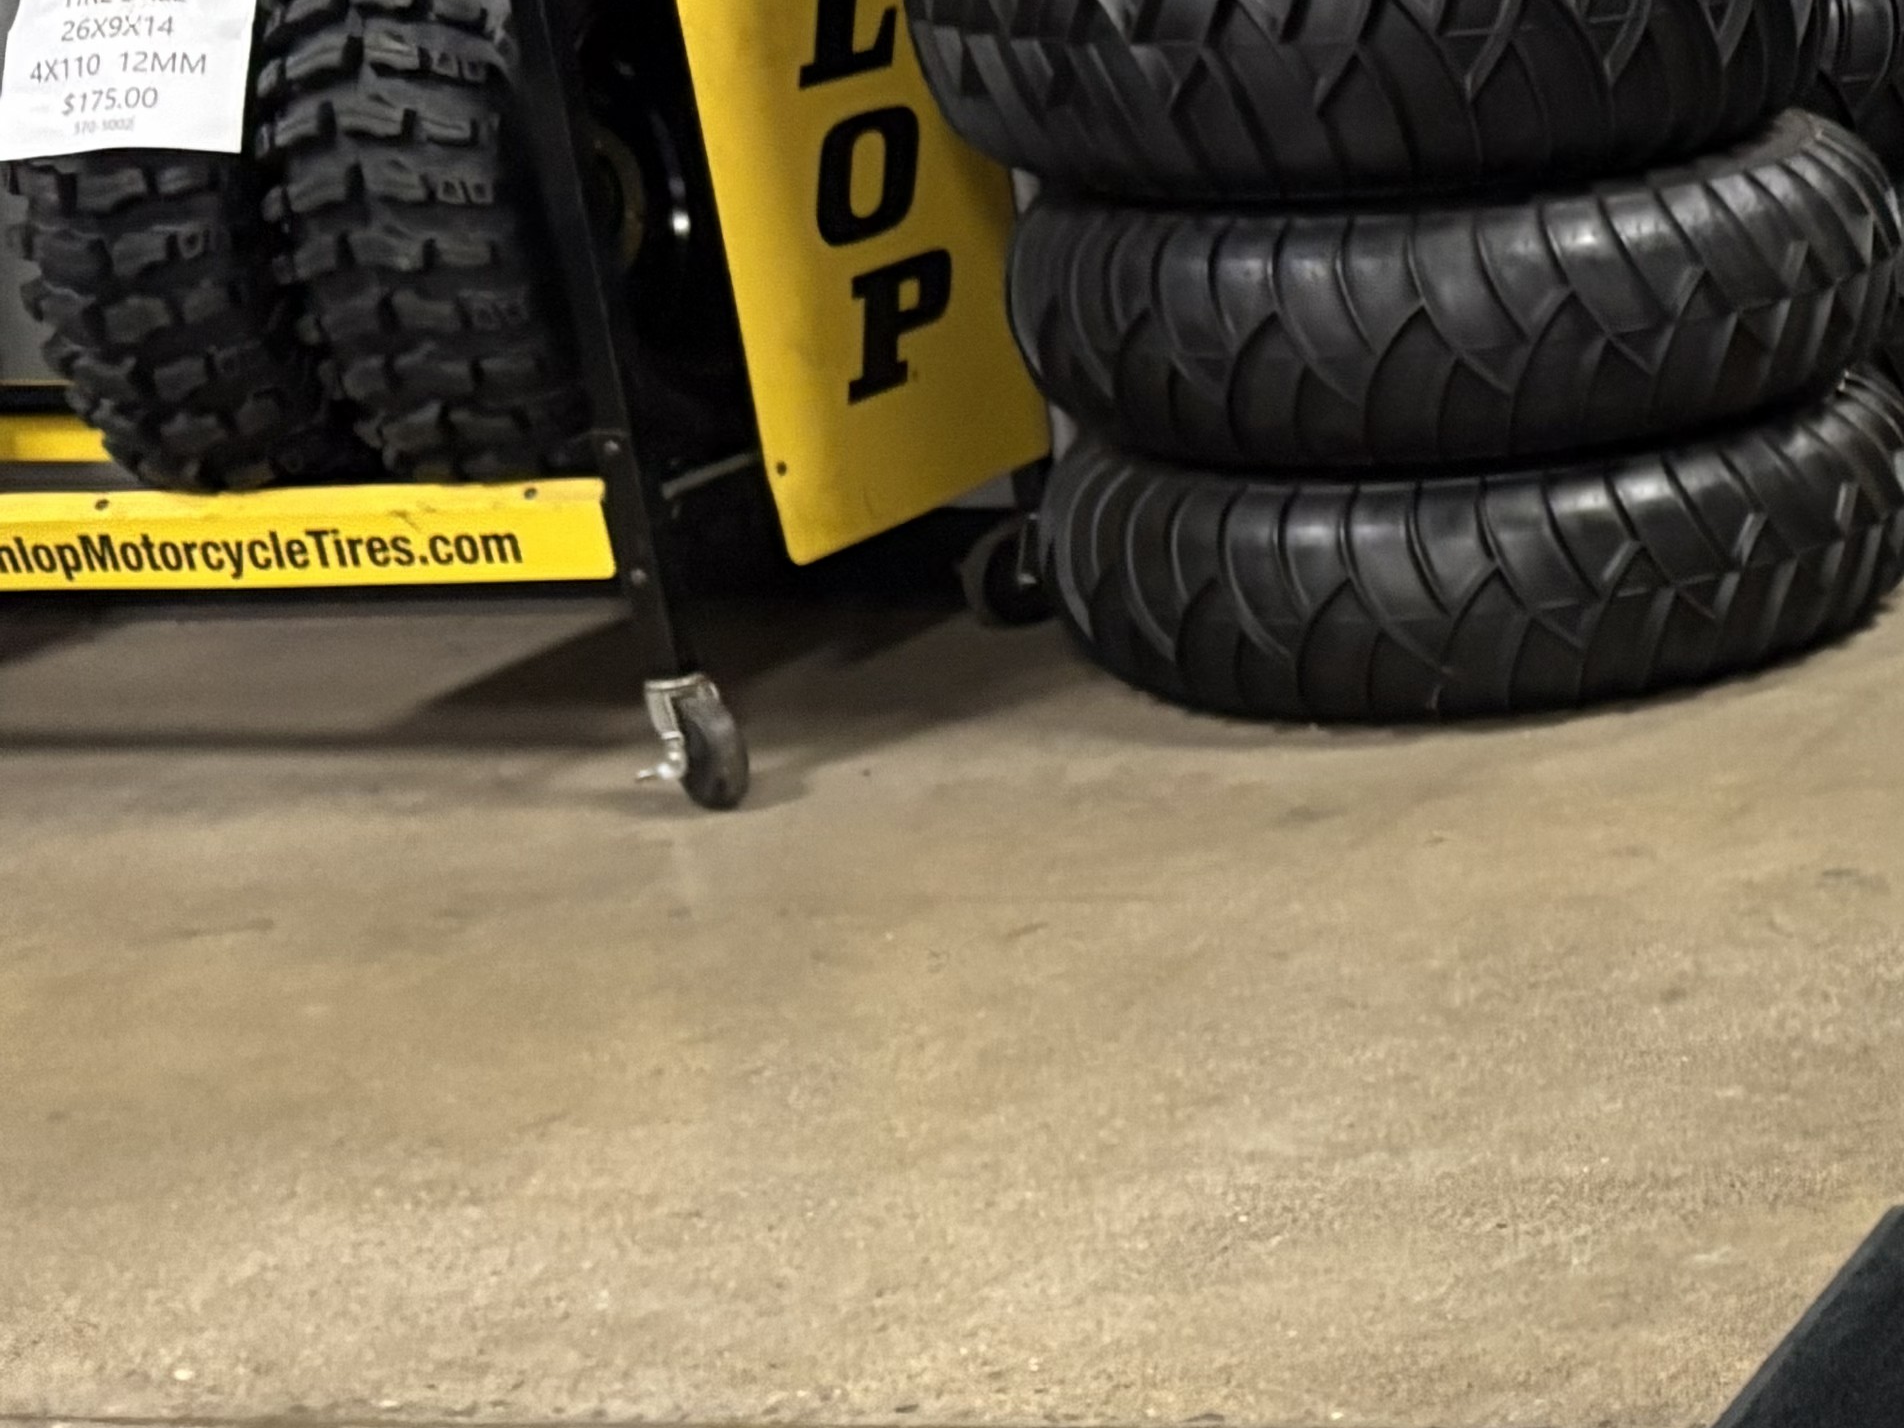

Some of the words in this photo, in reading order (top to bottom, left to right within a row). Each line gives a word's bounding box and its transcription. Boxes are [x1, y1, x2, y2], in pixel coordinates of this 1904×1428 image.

[60, 15, 175, 42] 26X9X14
[29, 53, 101, 84] 4X110
[118, 51, 207, 75] 12MM
[61, 86, 159, 117] $175.00
[0, 529, 523, 581] nlopMotorcycleTires.com
